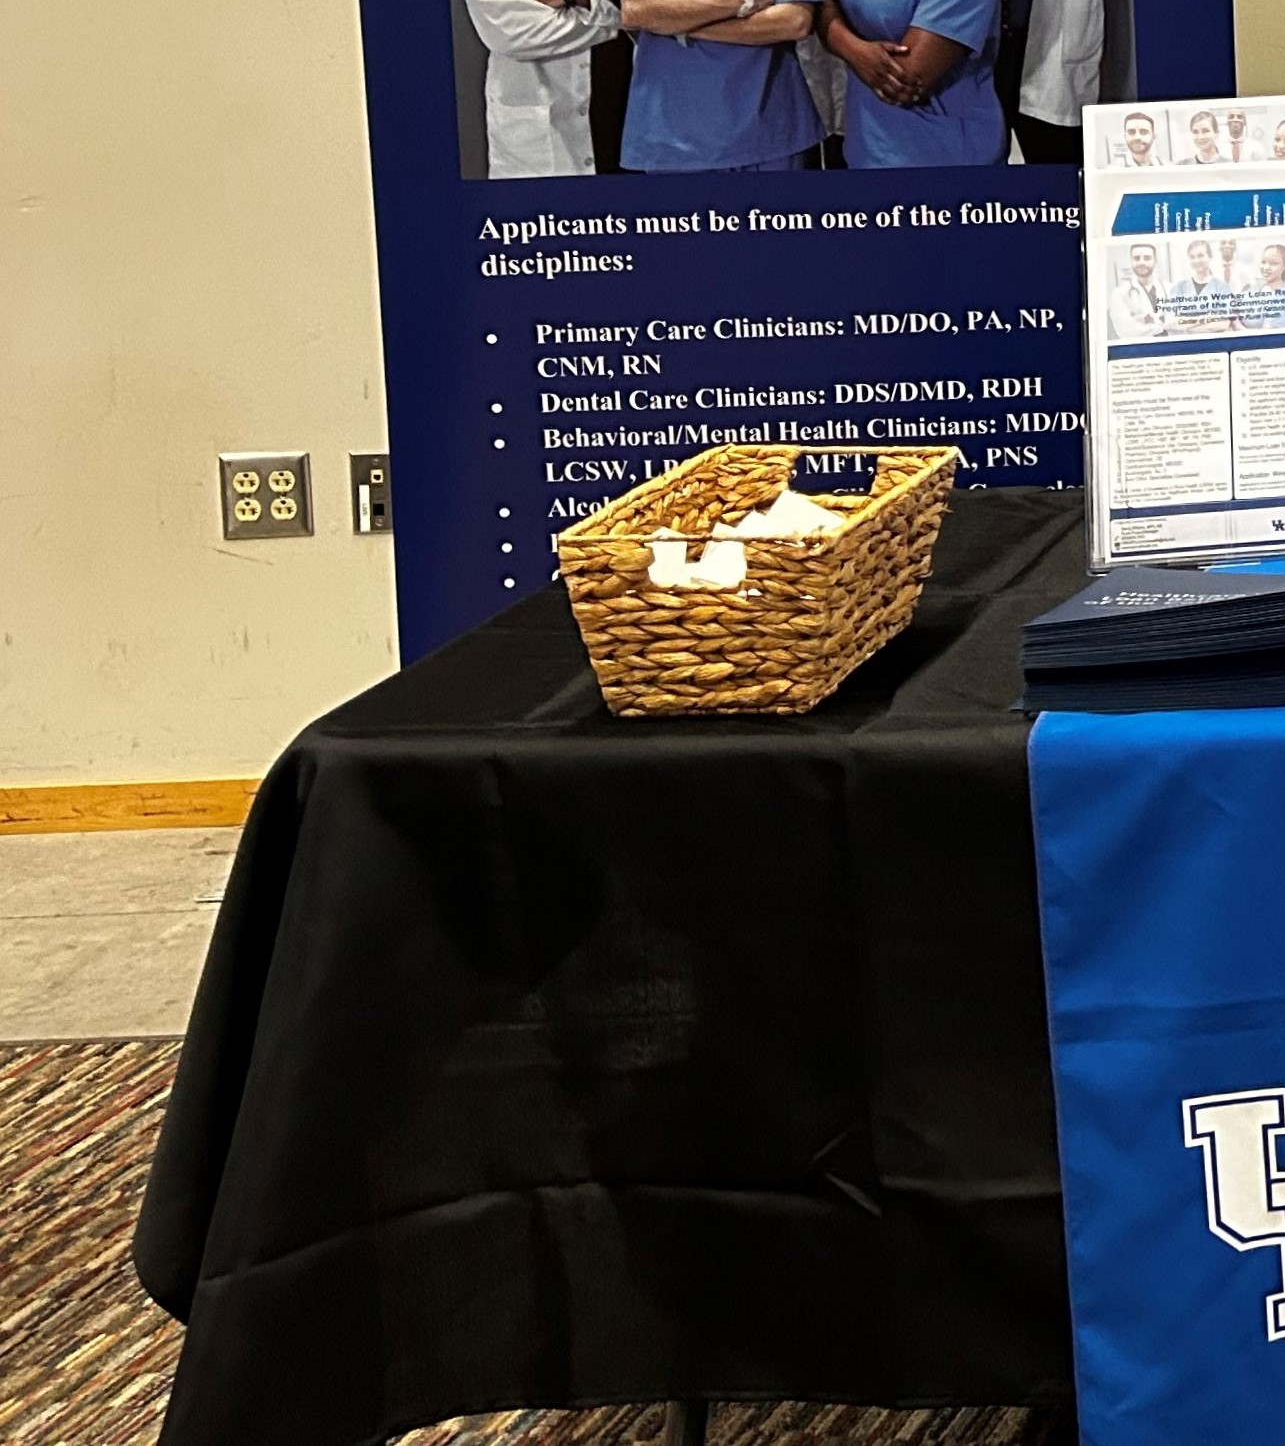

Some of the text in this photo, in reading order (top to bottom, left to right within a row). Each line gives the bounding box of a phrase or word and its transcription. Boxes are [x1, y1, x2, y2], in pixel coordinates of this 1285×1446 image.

[479, 202, 1080, 244] Applicants must be from one of the following
[482, 251, 633, 279] disciplines:
[537, 309, 1062, 346] Primary Care Clinicians: MD/DO, PA, NP,
[538, 355, 660, 378] CNM, RN
[541, 378, 1042, 412] Dental Care Clinicians: DDS/DMD, RDH
[543, 421, 771, 450] Behavioral/Mental
[779, 419, 860, 444] Health
[867, 417, 996, 438] Clinicians:
[545, 459, 637, 488] LCSW,
[805, 451, 875, 476] MFT,
[987, 446, 1037, 467] PNS
